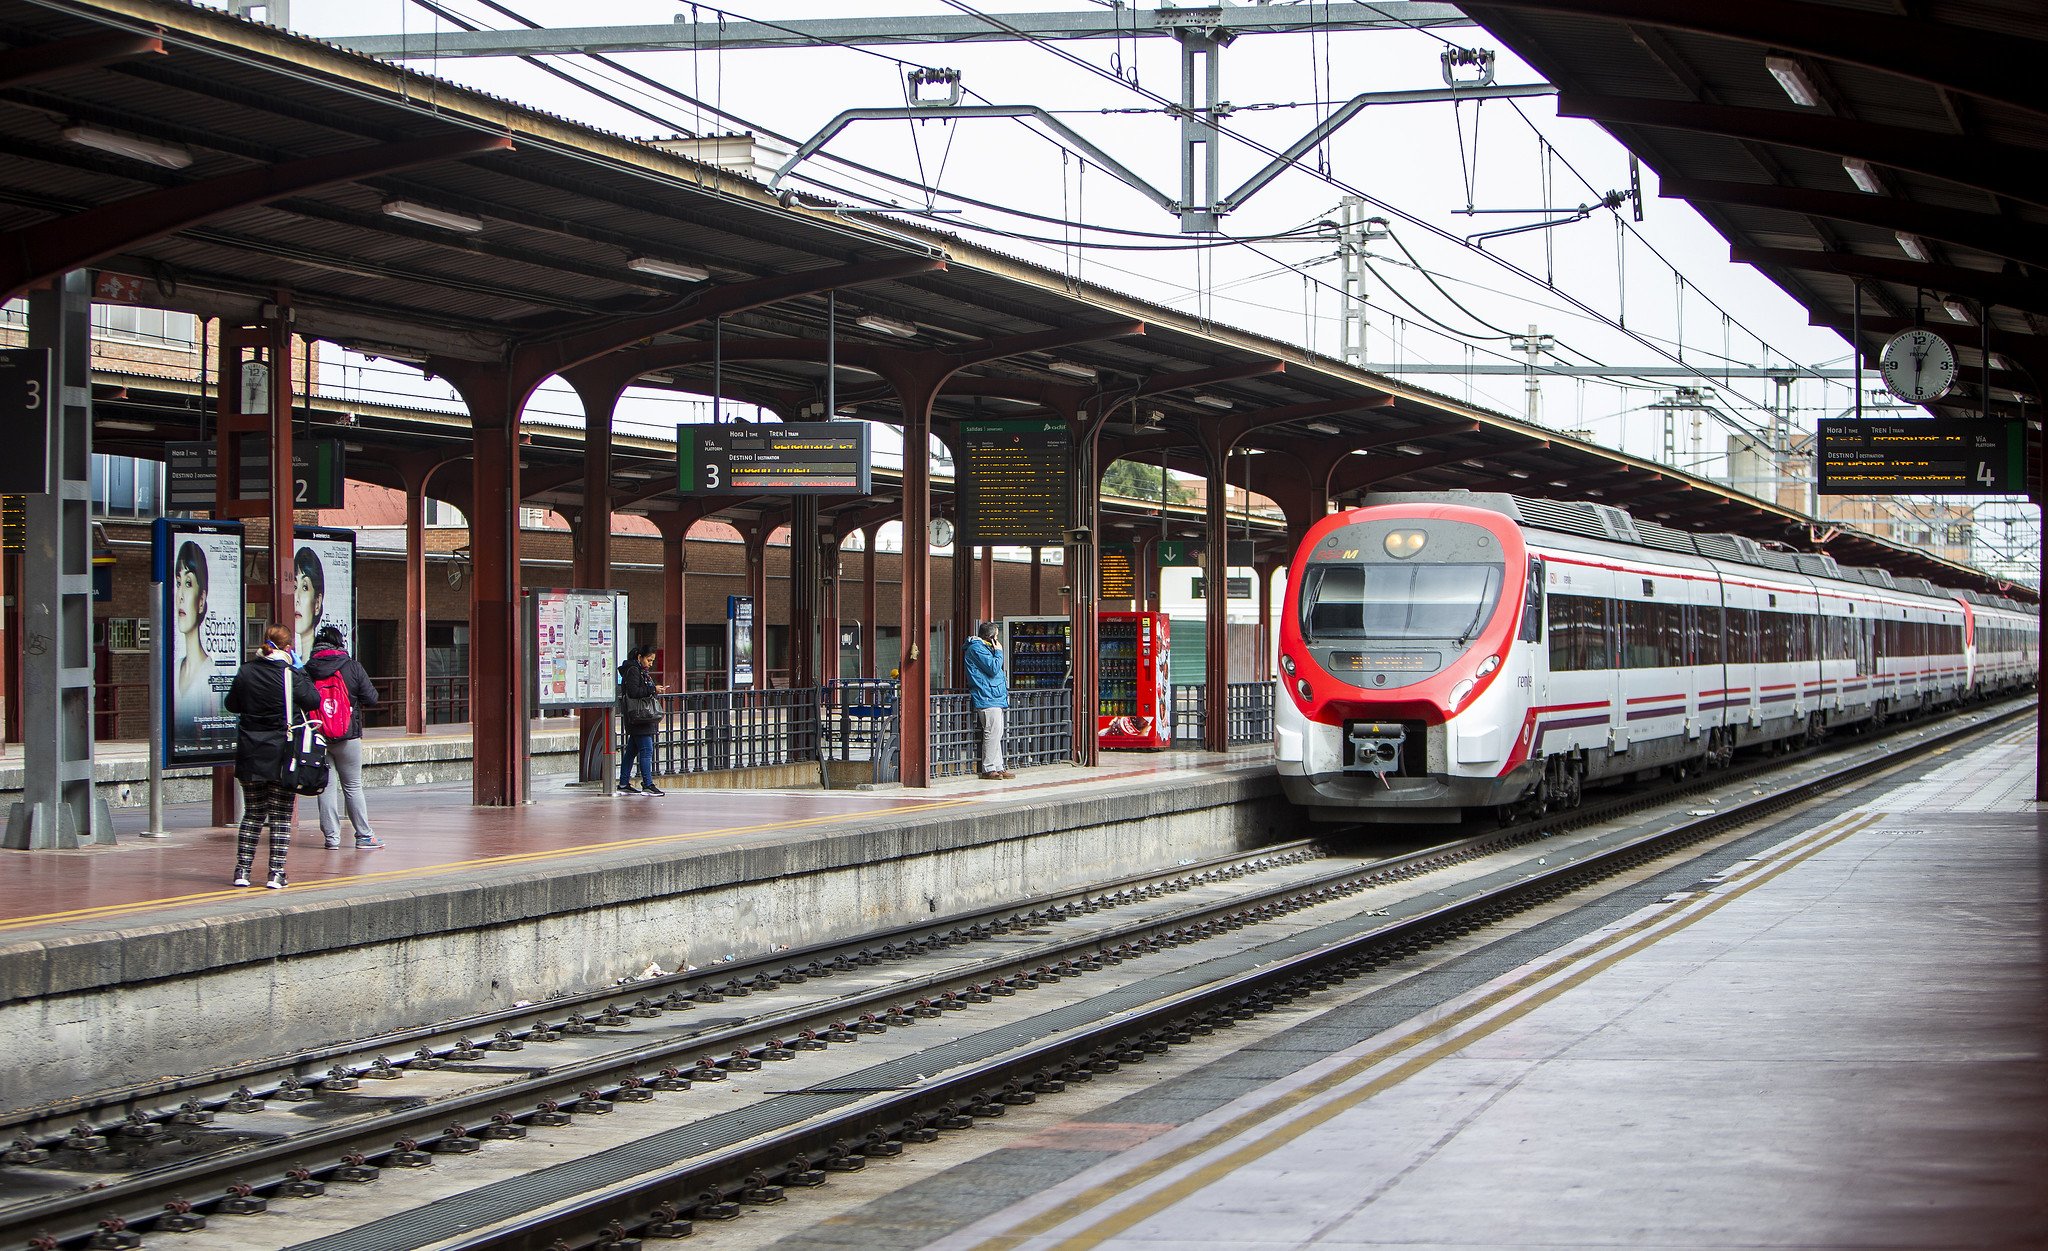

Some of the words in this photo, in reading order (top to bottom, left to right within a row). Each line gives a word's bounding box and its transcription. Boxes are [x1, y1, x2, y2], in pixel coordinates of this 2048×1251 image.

[1913, 336, 1926, 345] 12
[1890, 360, 1898, 370] 9
[1940, 361, 1949, 370] 3
[25, 379, 40, 410] 3
[1915, 386, 1924, 395] 6
[706, 464, 720, 489] 3
[1976, 461, 1995, 487] 4
[295, 479, 308, 503] 2
[1517, 668, 1532, 695] renfe
